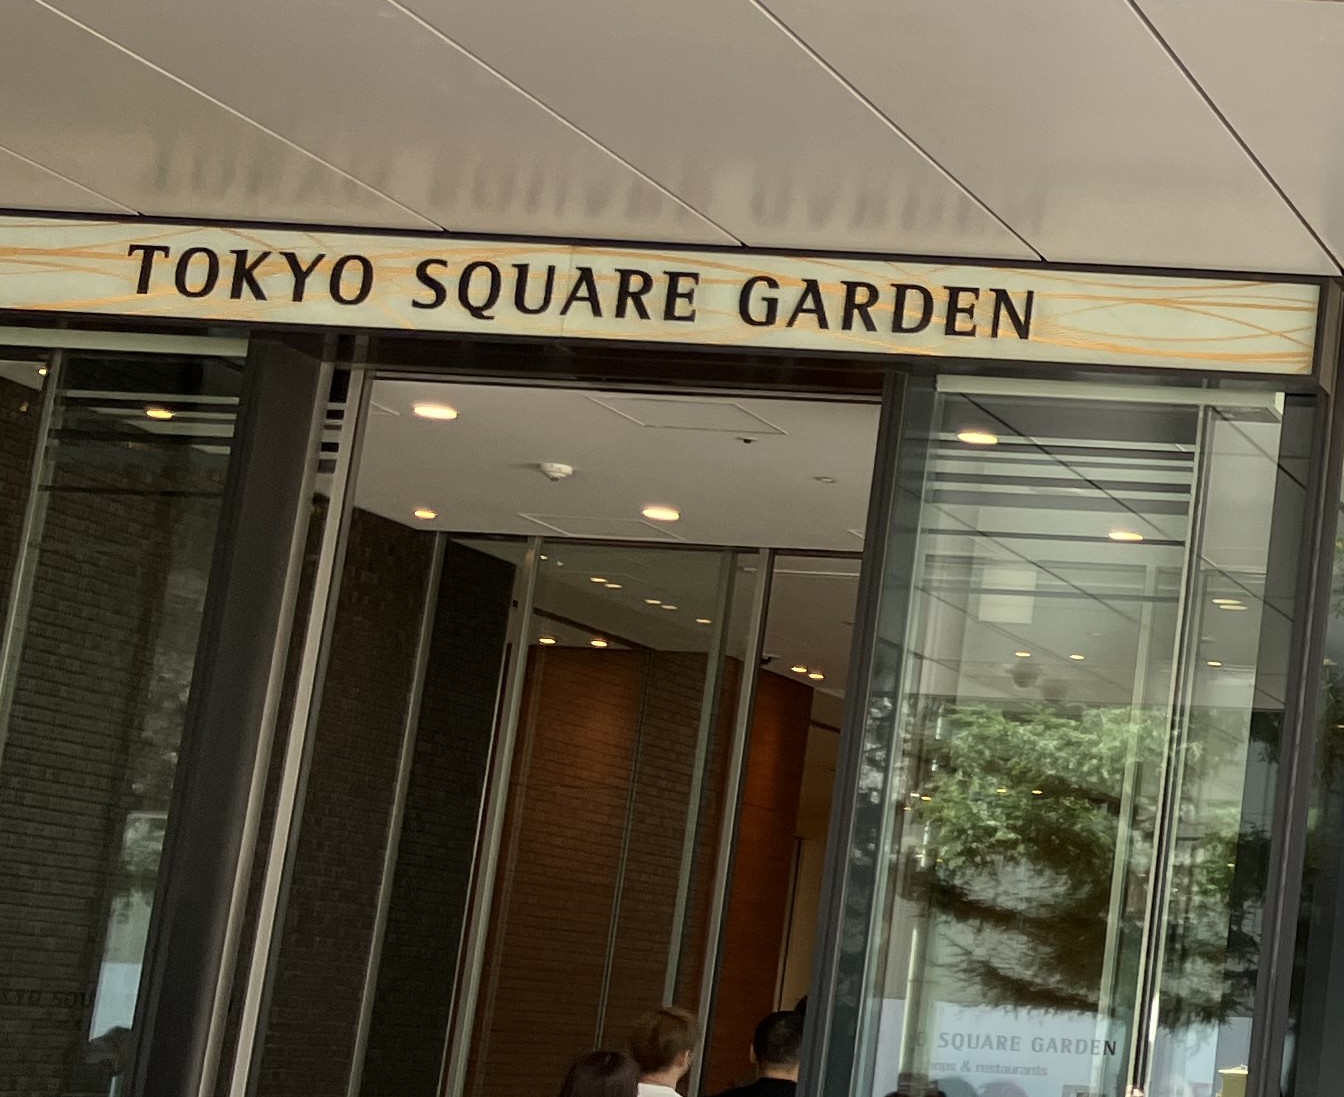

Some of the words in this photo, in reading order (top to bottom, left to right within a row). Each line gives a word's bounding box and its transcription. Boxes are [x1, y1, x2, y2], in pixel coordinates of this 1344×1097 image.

[127, 243, 375, 306] TOKYO
[410, 258, 703, 322] SQUARE
[738, 275, 1035, 341] GARDEN
[938, 1032, 1021, 1051] SQUARE
[1031, 1036, 1117, 1056] GARDEN
[960, 1061, 972, 1072] &
[976, 1063, 1048, 1077] restaurants
